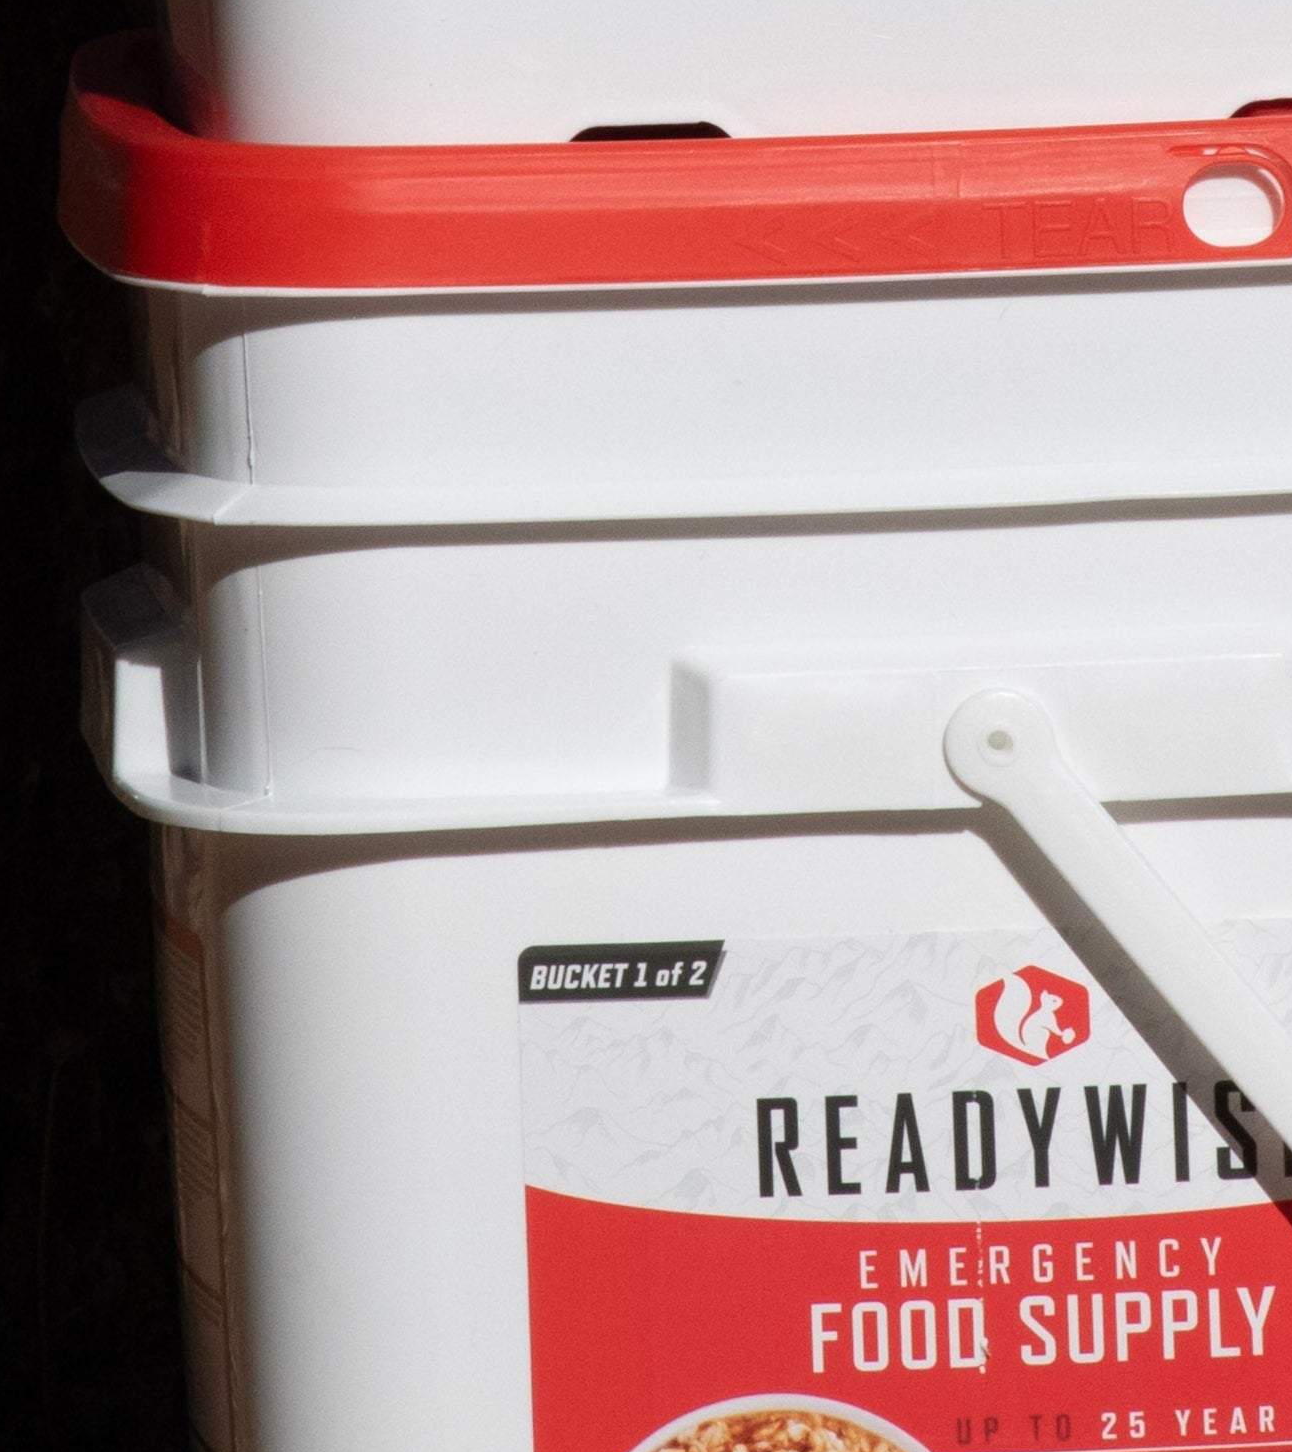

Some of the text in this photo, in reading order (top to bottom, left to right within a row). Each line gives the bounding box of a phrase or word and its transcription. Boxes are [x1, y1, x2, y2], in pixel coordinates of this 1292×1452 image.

[530, 960, 707, 990] BUCKET 1 of 2
[859, 1237, 1221, 1289] EMERGENCY
[811, 1286, 1275, 1373] FOOD SUPPLY
[956, 1416, 999, 1445] UP
[1030, 1413, 1071, 1442] TO
[1101, 1411, 1145, 1439] 25
[1175, 1405, 1274, 1436] YEAR
